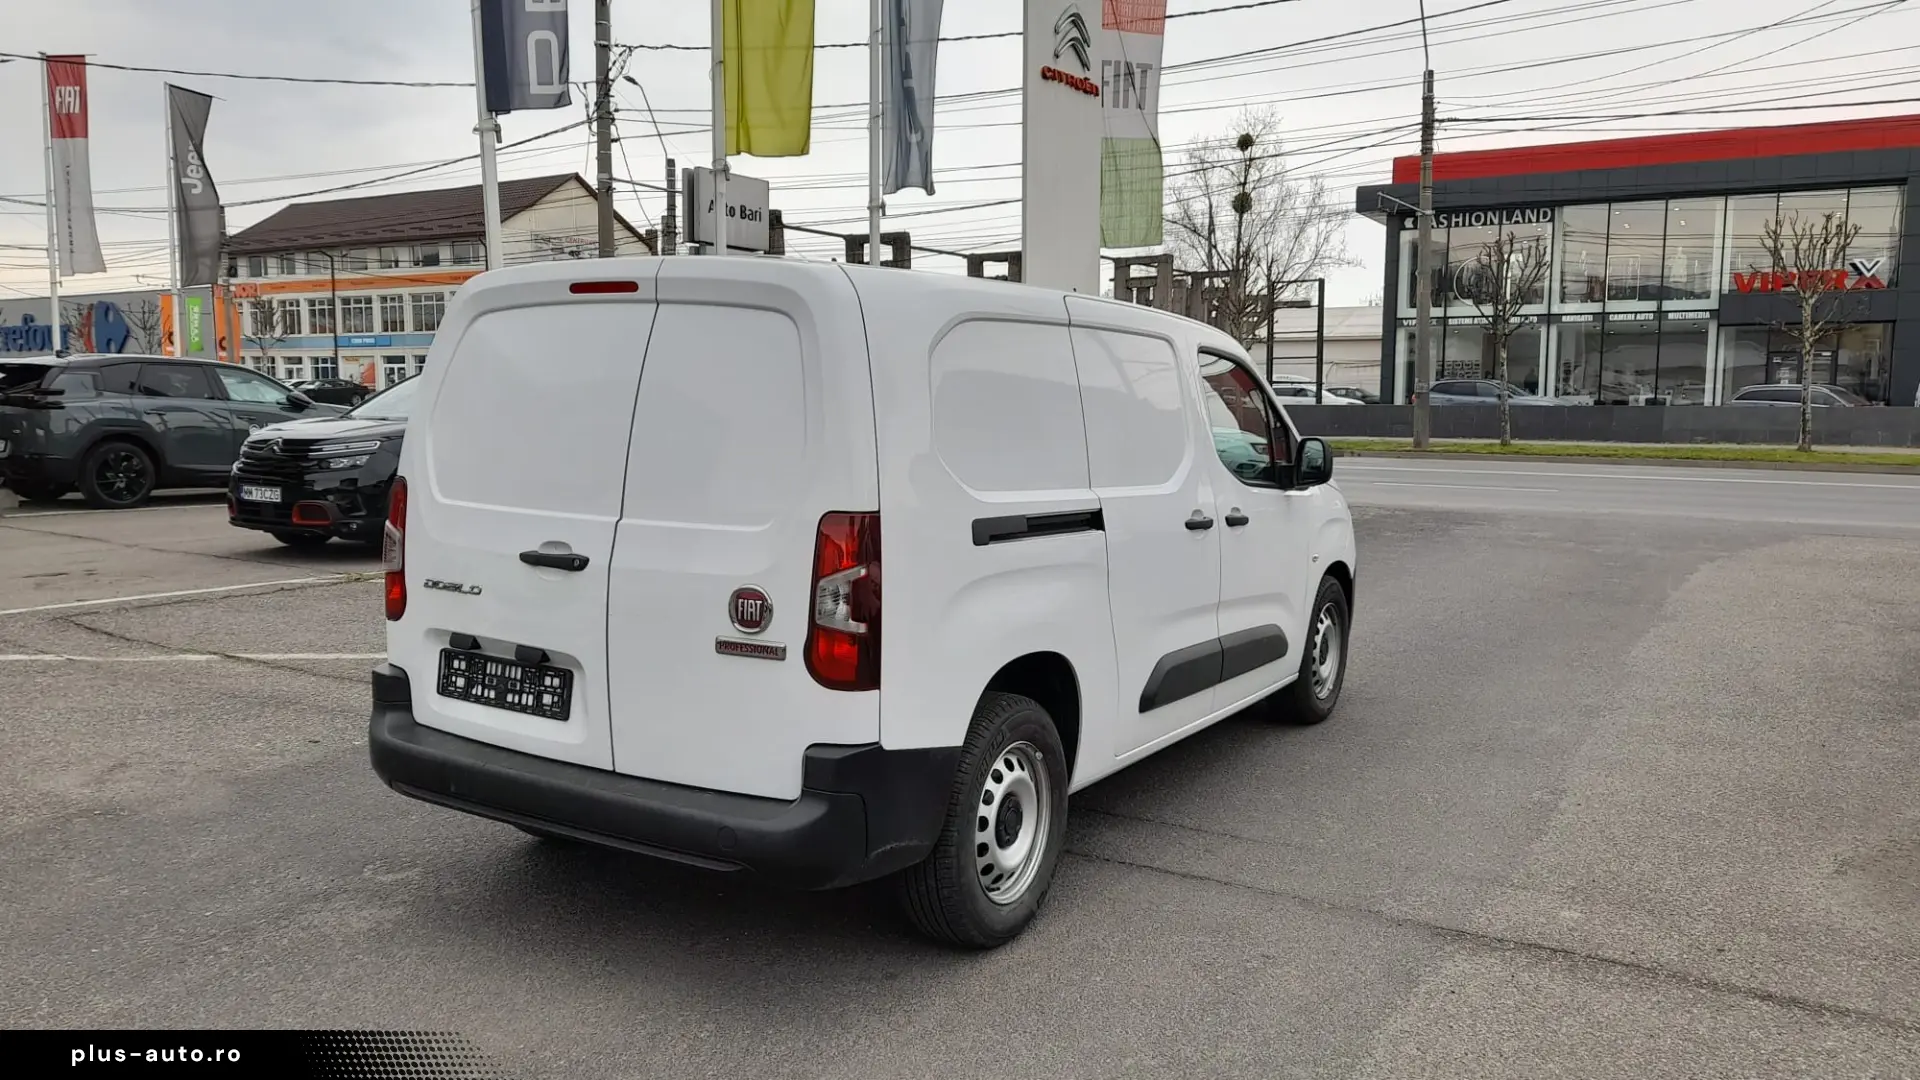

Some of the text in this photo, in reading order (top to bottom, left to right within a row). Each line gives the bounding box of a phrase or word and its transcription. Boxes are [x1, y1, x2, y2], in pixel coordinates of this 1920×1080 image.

[1041, 65, 1100, 97] CITROËN
[1101, 60, 1153, 110] FIAT
[55, 86, 81, 114] FIAT
[708, 199, 762, 222] Ato Bari
[1418, 207, 1552, 229] ASHIONLAND
[1636, 312, 1654, 320] AUTO
[1668, 311, 1711, 320] MULTIMEDIA
[424, 578, 482, 596] DOBLO
[738, 598, 763, 621] FIAT
[719, 640, 779, 657] PROFESSIONAL
